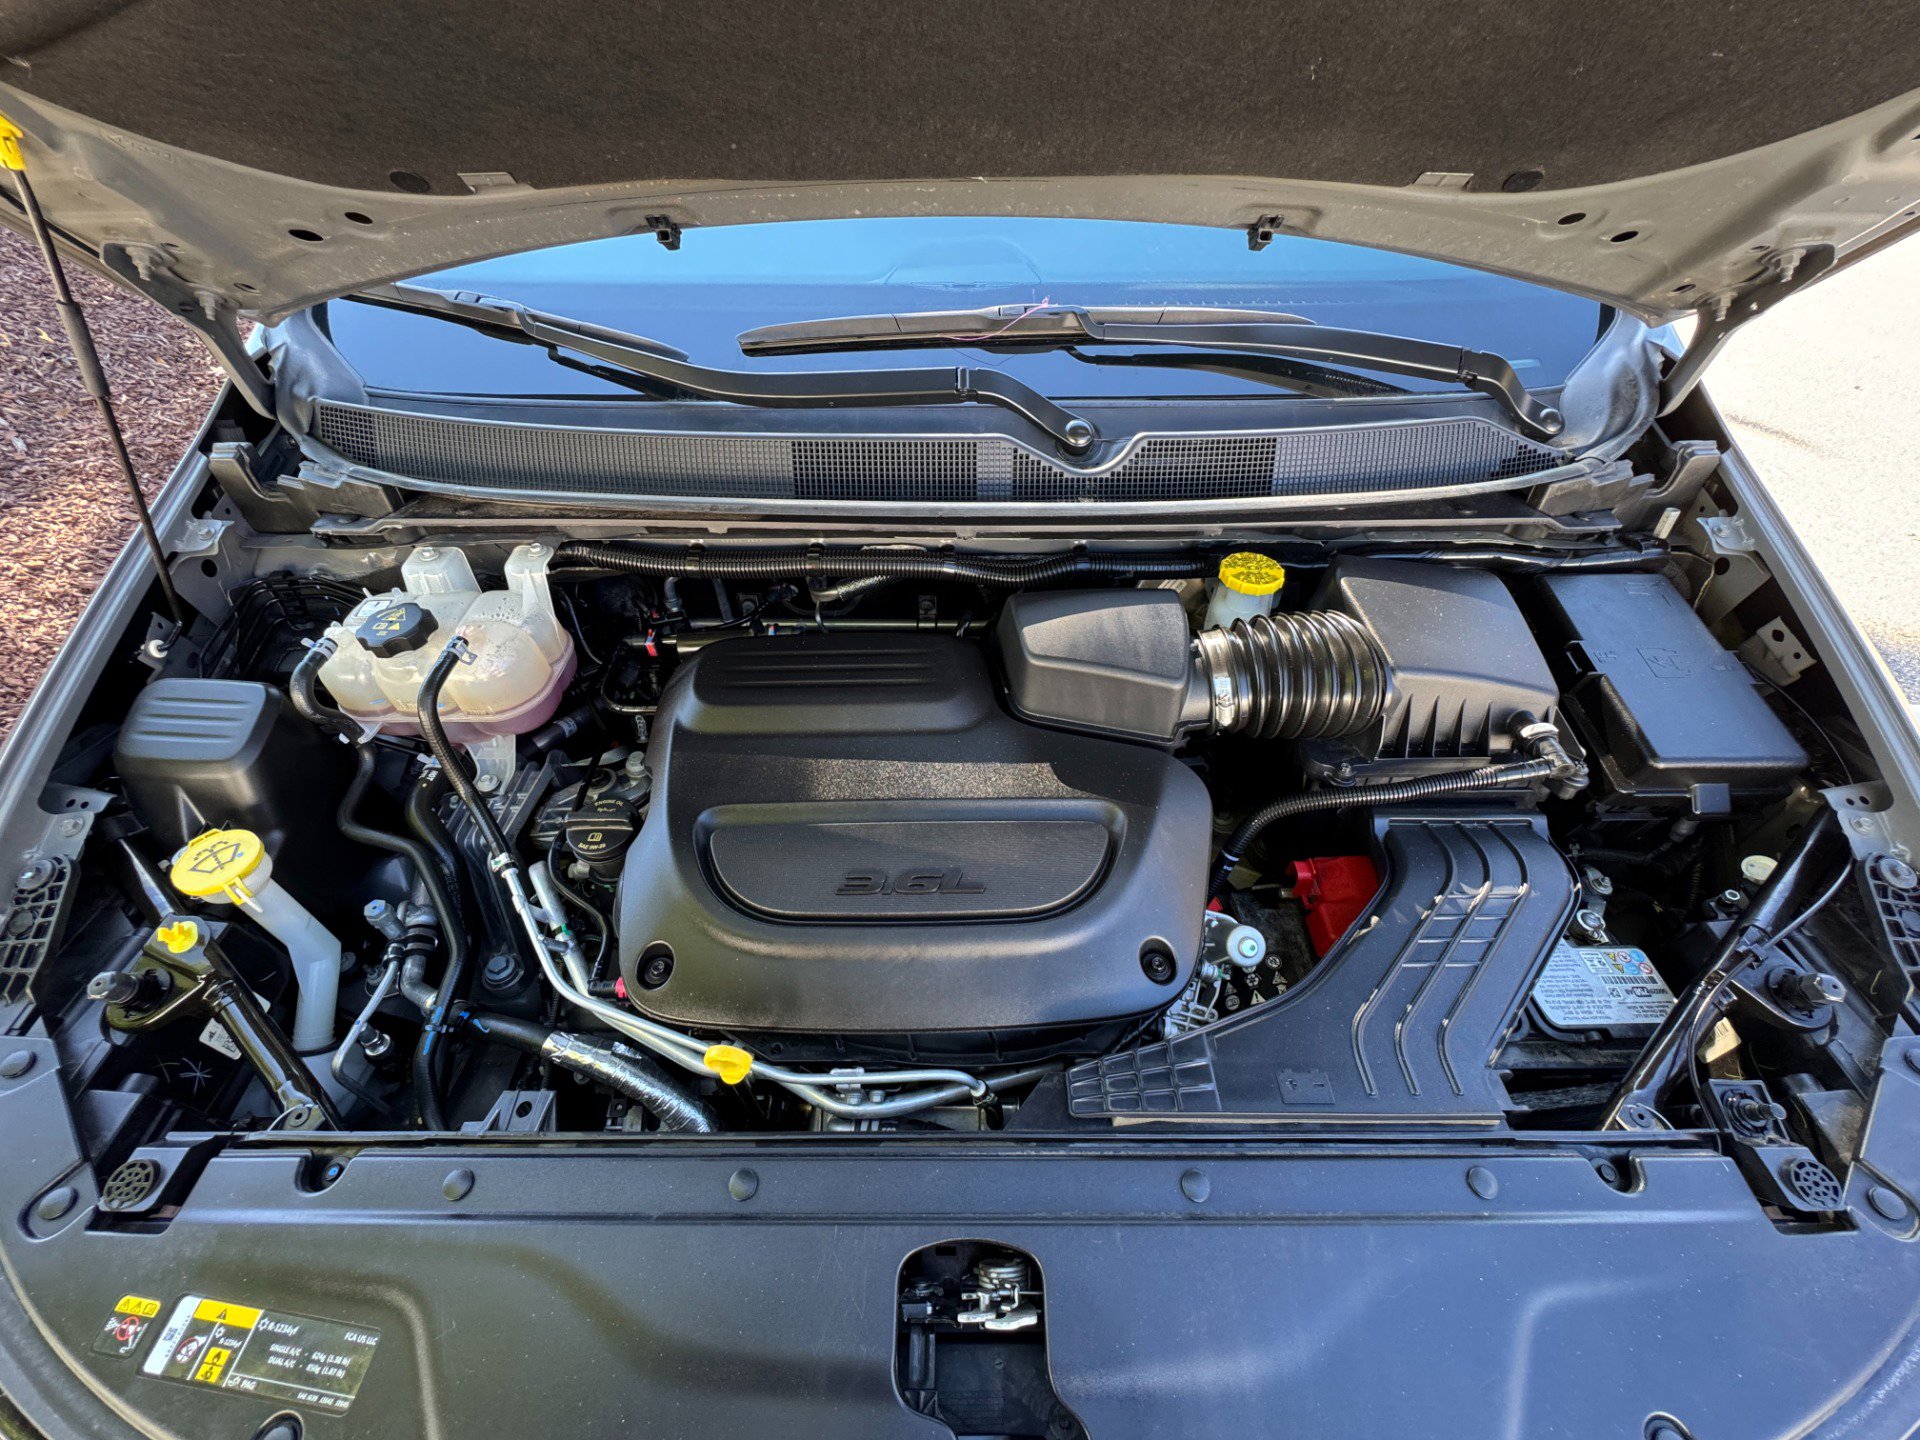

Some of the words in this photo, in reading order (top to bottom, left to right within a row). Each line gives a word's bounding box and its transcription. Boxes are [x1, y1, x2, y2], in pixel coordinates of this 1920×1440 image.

[835, 866, 987, 896] 3.6L
[268, 1321, 300, 1337] R-1234yf
[344, 1331, 358, 1342] FCA
[357, 1334, 367, 1344] US
[366, 1336, 379, 1346] LLC
[269, 1342, 291, 1354] SINGLE
[267, 1355, 285, 1366] DUAL
[240, 1379, 256, 1391] PAG
